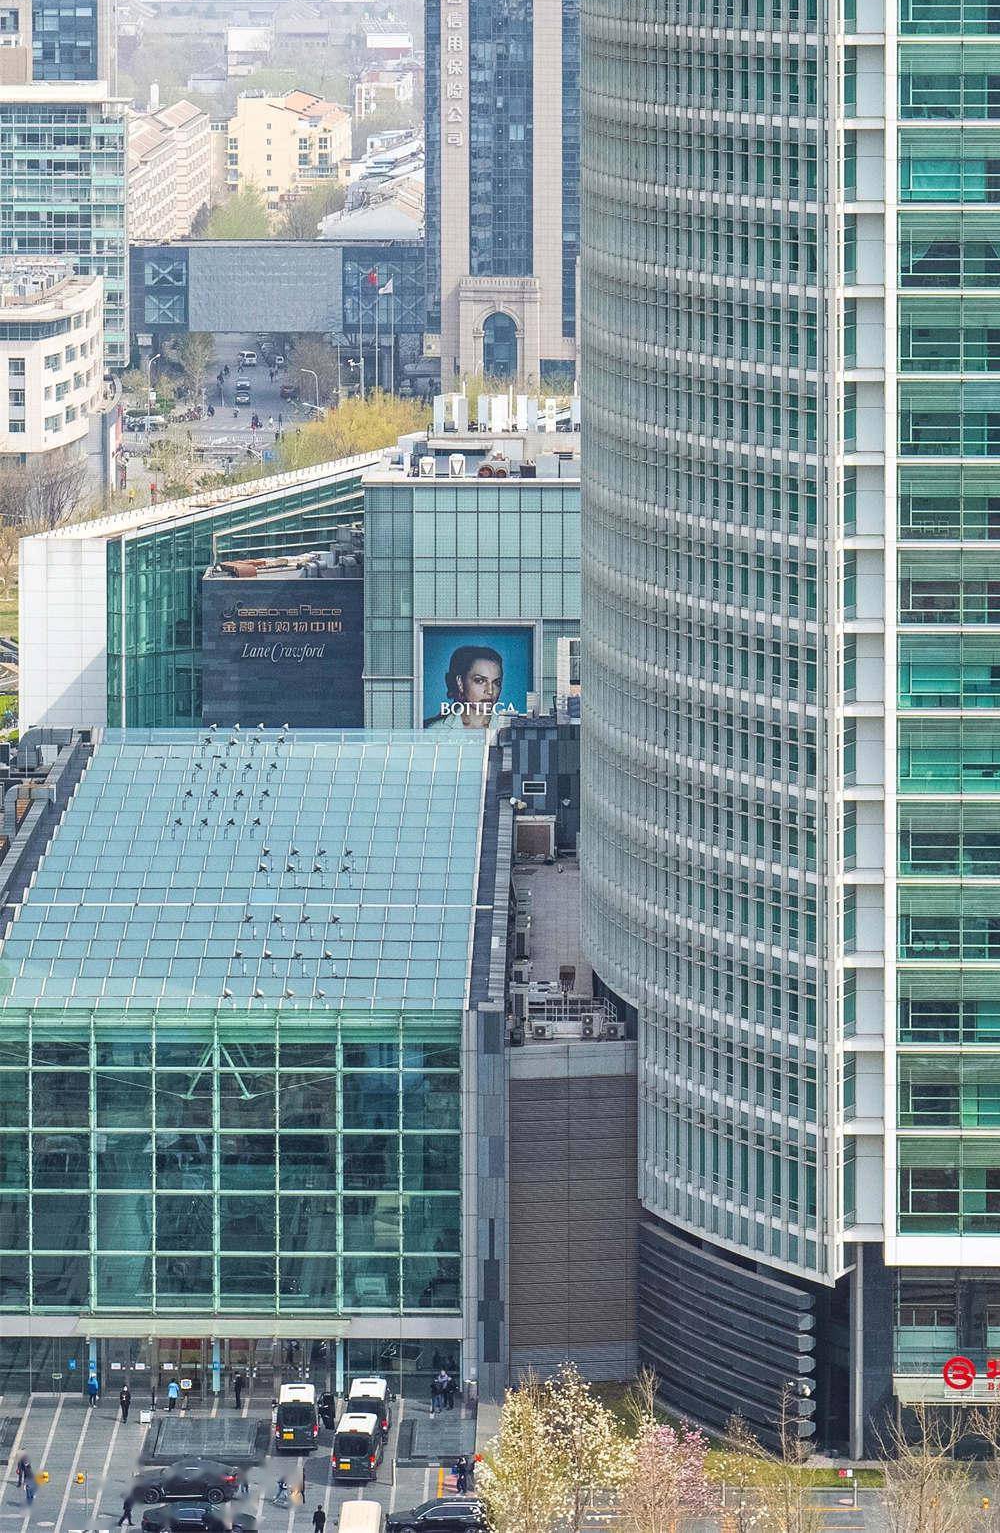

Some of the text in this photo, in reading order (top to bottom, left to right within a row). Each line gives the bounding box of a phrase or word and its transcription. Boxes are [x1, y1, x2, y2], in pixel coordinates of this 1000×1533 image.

[221, 621, 342, 633] 金融街购物中心
[440, 701, 519, 716] BOTTEGA
